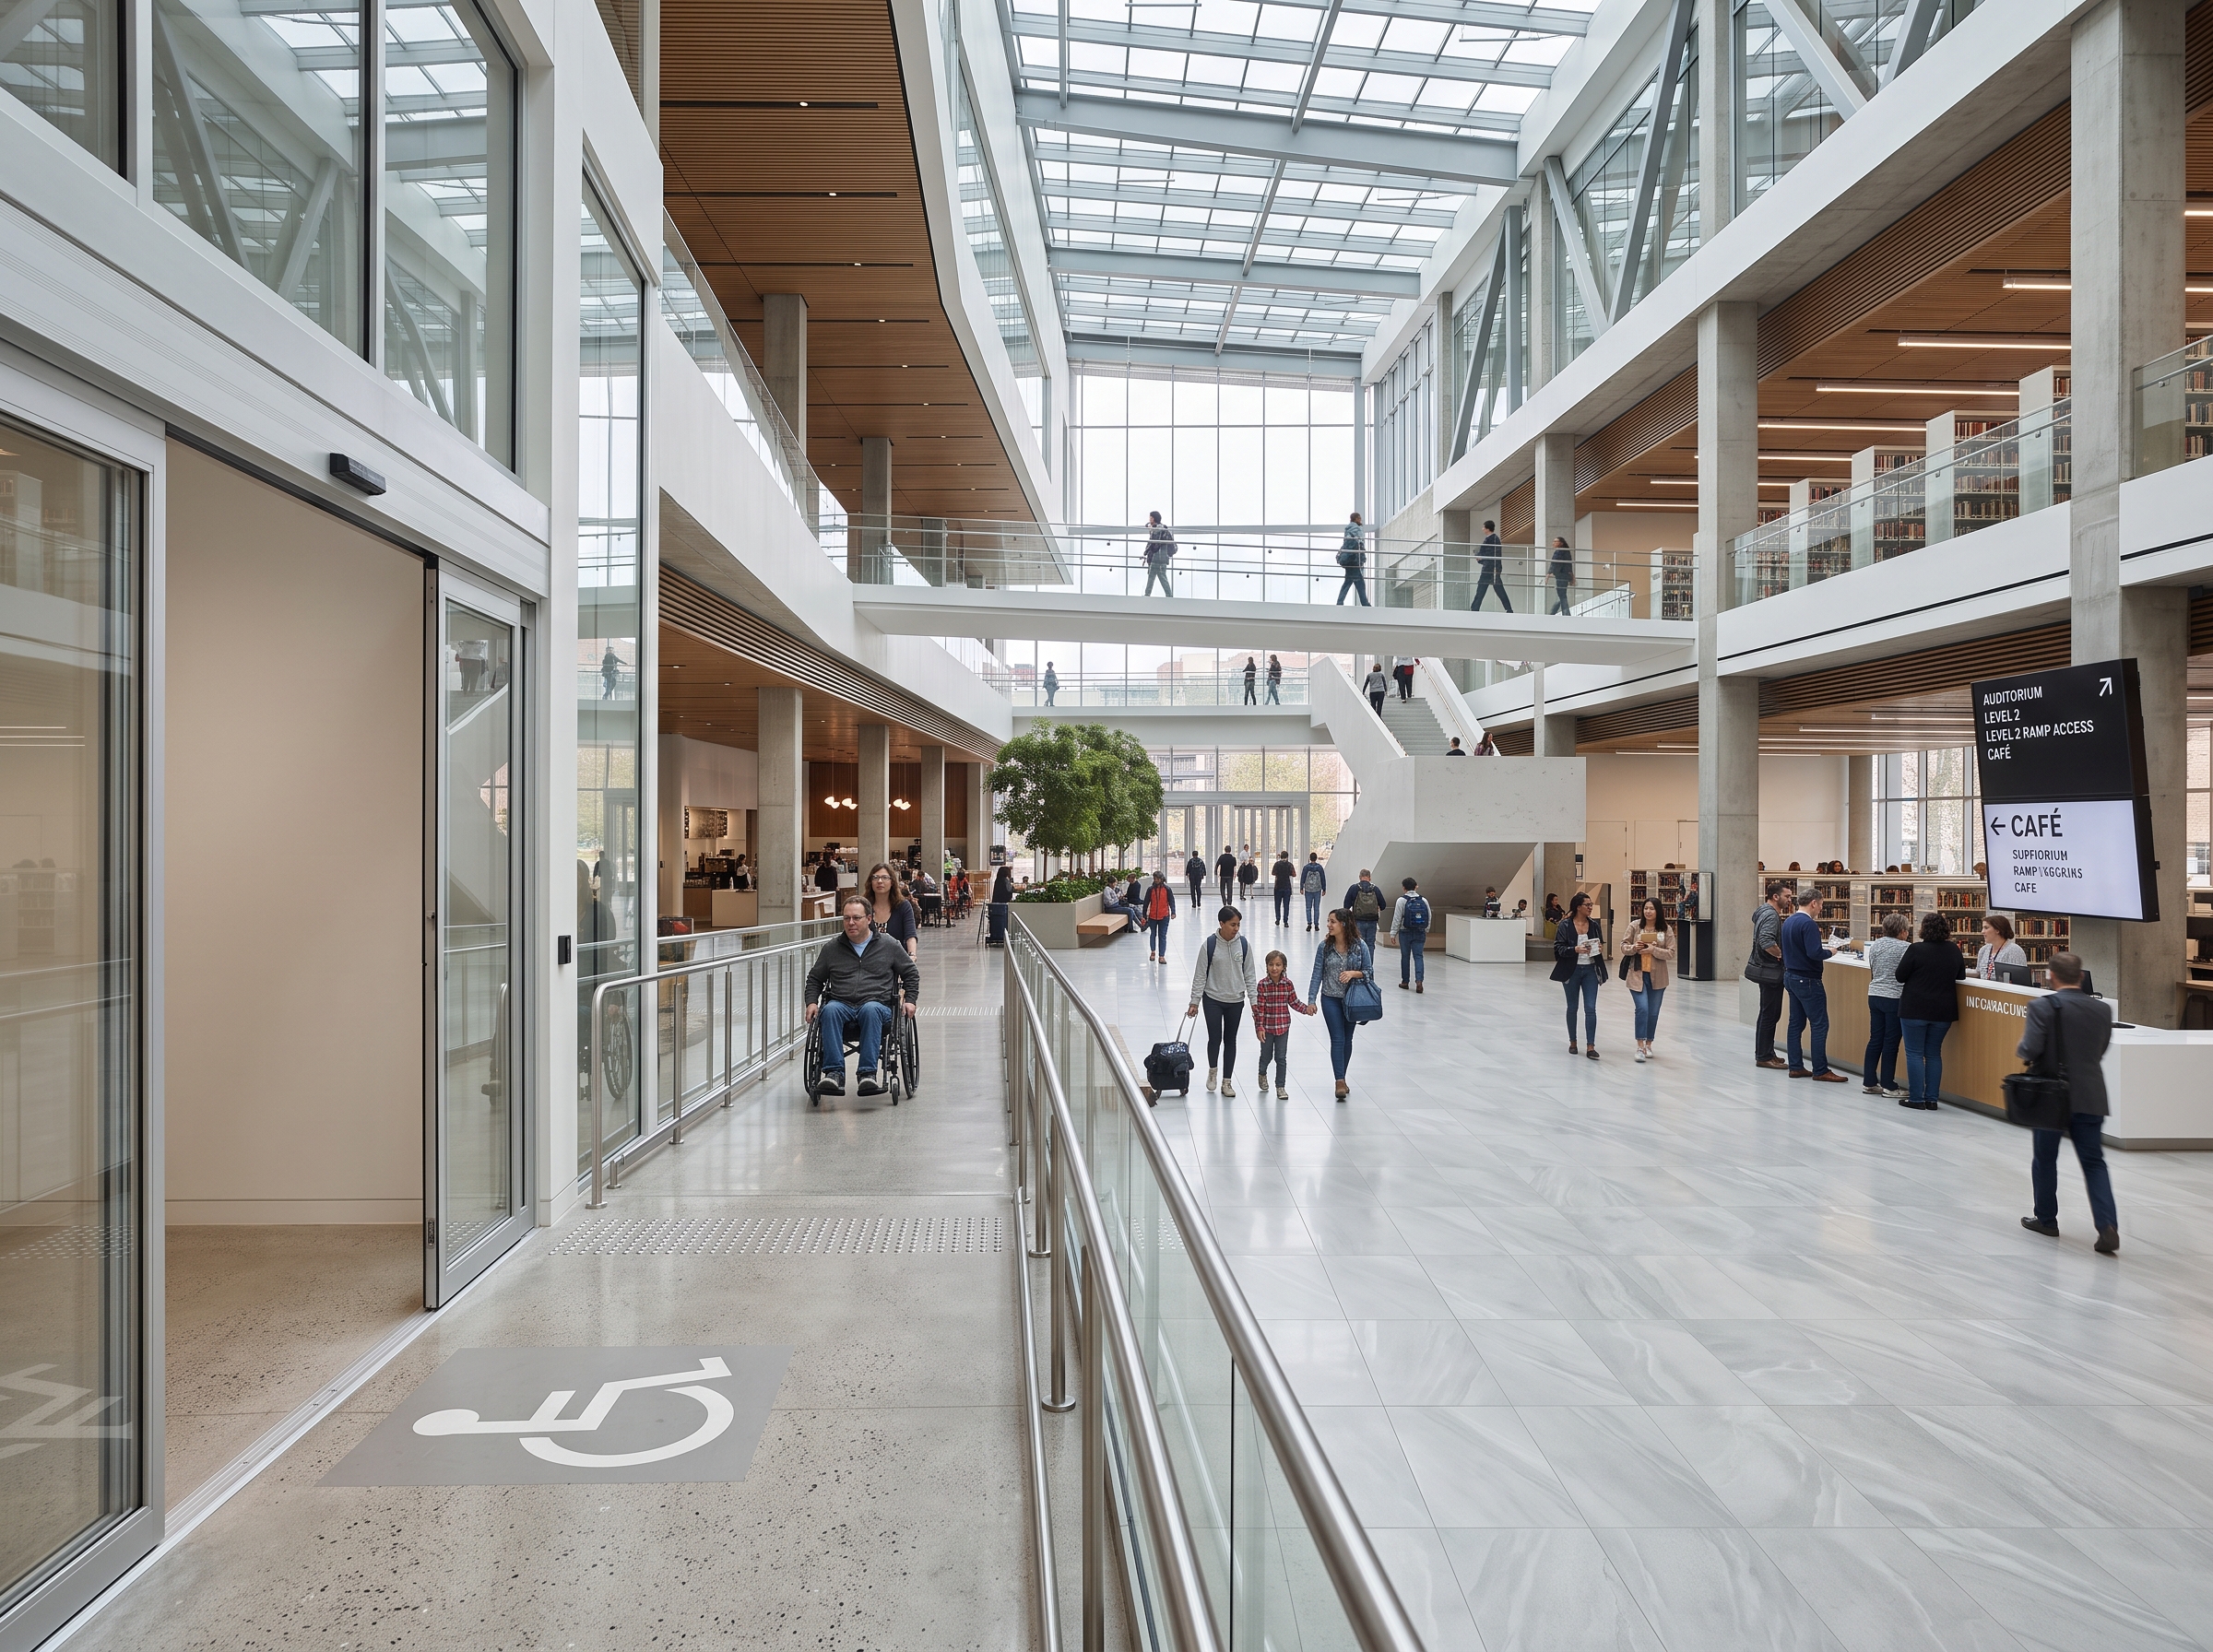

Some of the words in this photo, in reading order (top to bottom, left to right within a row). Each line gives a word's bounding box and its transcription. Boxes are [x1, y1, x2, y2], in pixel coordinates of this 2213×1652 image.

[1983, 686, 2042, 705] AUDITORIUM
[1984, 710, 2012, 724] LEVEL
[2014, 709, 2020, 721] 2
[1986, 728, 2014, 742] LEVEL
[2015, 727, 2021, 739] 2
[2023, 725, 2051, 738] RAMP
[2053, 720, 2094, 736] ACCESS
[1987, 744, 2011, 761] CAFÉ
[2011, 808, 2064, 838] CAFÉ
[2013, 866, 2037, 877] RAMP
[2015, 882, 2037, 893] CAFE
